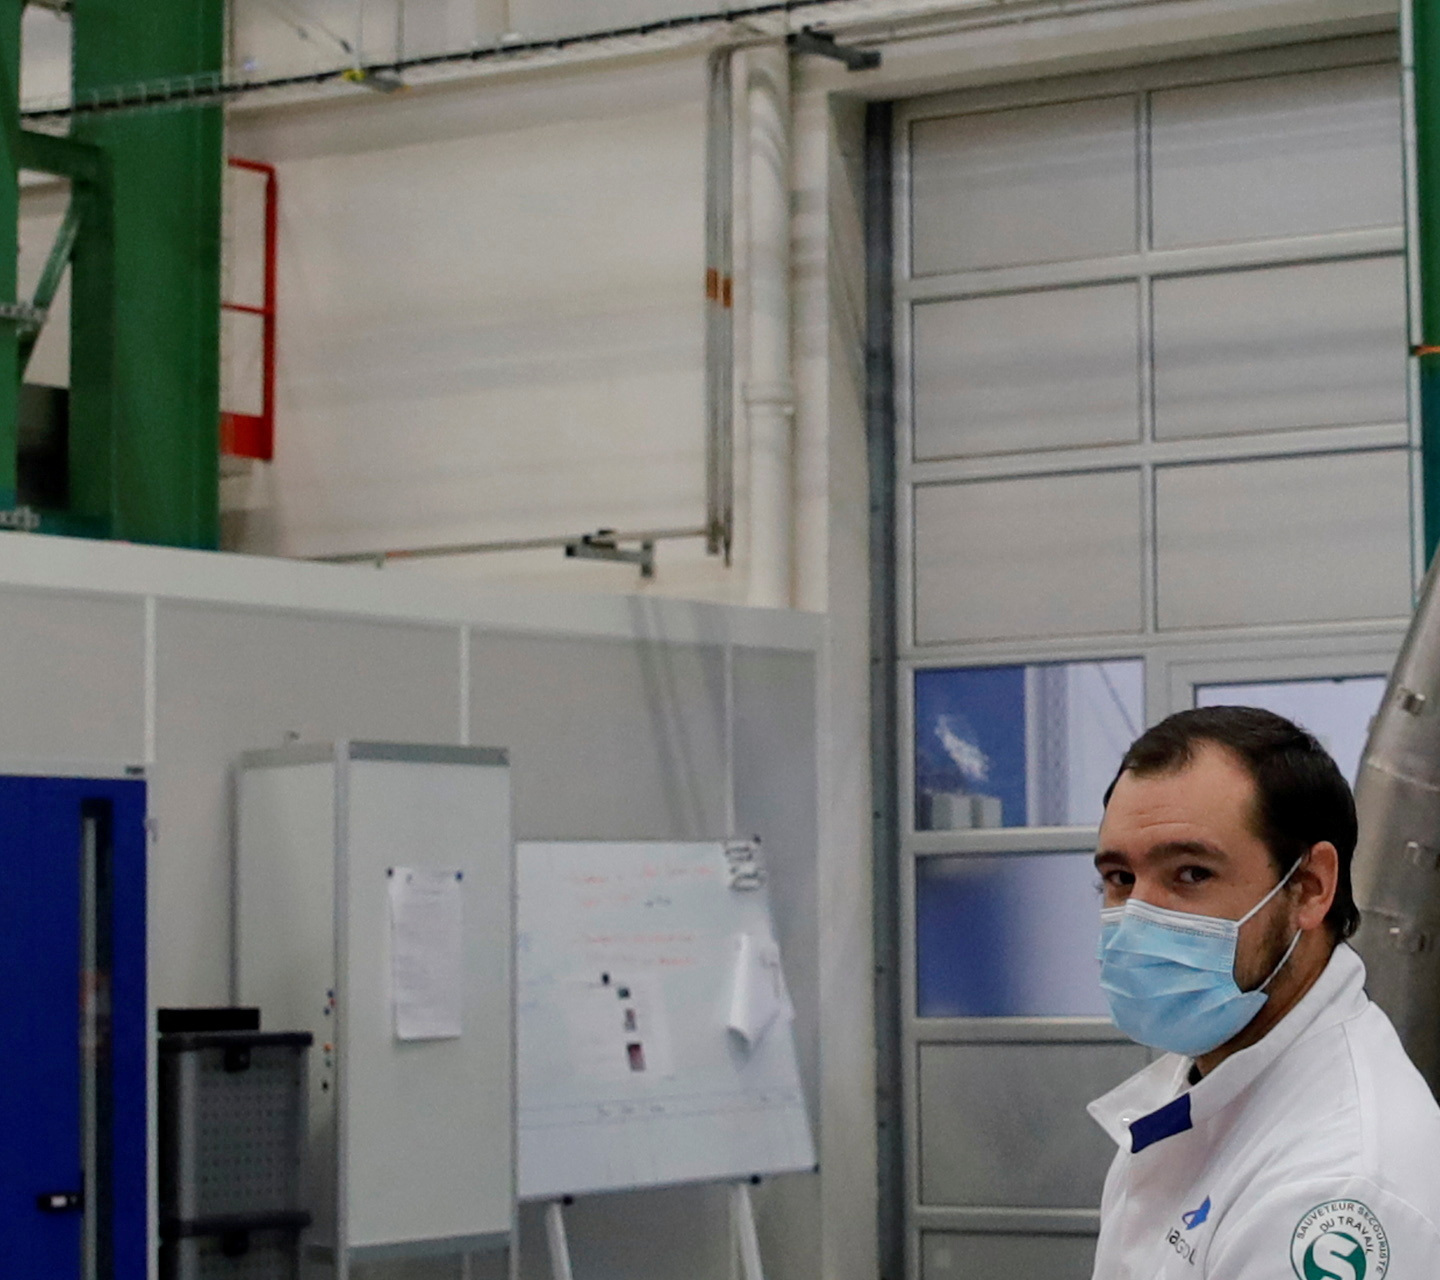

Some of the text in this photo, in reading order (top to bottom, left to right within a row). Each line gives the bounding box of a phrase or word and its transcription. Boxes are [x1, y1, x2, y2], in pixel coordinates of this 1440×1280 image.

[1296, 1202, 1388, 1274] SAUVETEUR SECOURISTE
[1319, 1216, 1374, 1255] DU TRAVAIL
